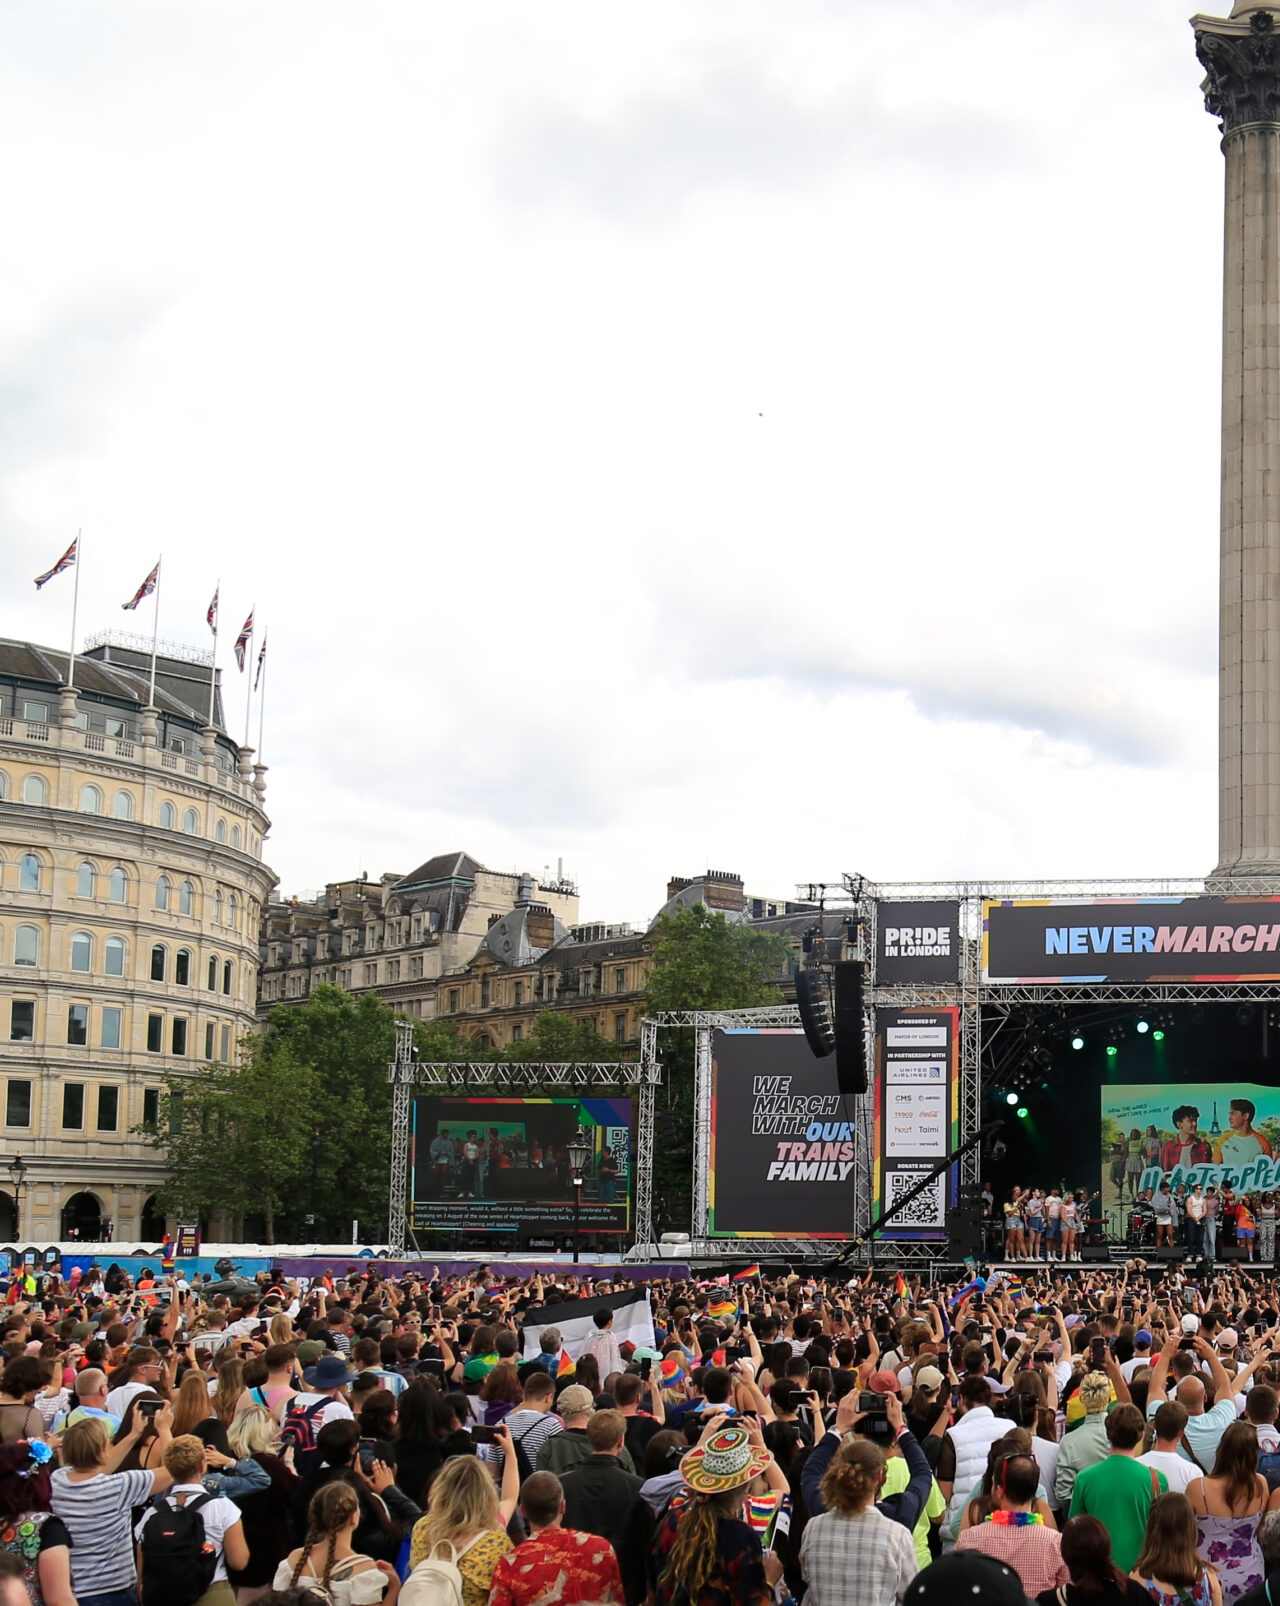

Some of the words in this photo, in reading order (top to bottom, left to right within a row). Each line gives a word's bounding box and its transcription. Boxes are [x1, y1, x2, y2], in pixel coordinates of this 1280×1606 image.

[885, 946, 898, 956] IN
[901, 945, 950, 956] LONDON
[753, 1076, 792, 1095] WE
[752, 1095, 840, 1115] MARCH
[752, 1115, 814, 1134] WITH
[806, 1122, 855, 1142] OUR
[777, 1142, 855, 1161] TRANS
[766, 1162, 855, 1181] FAMILY
